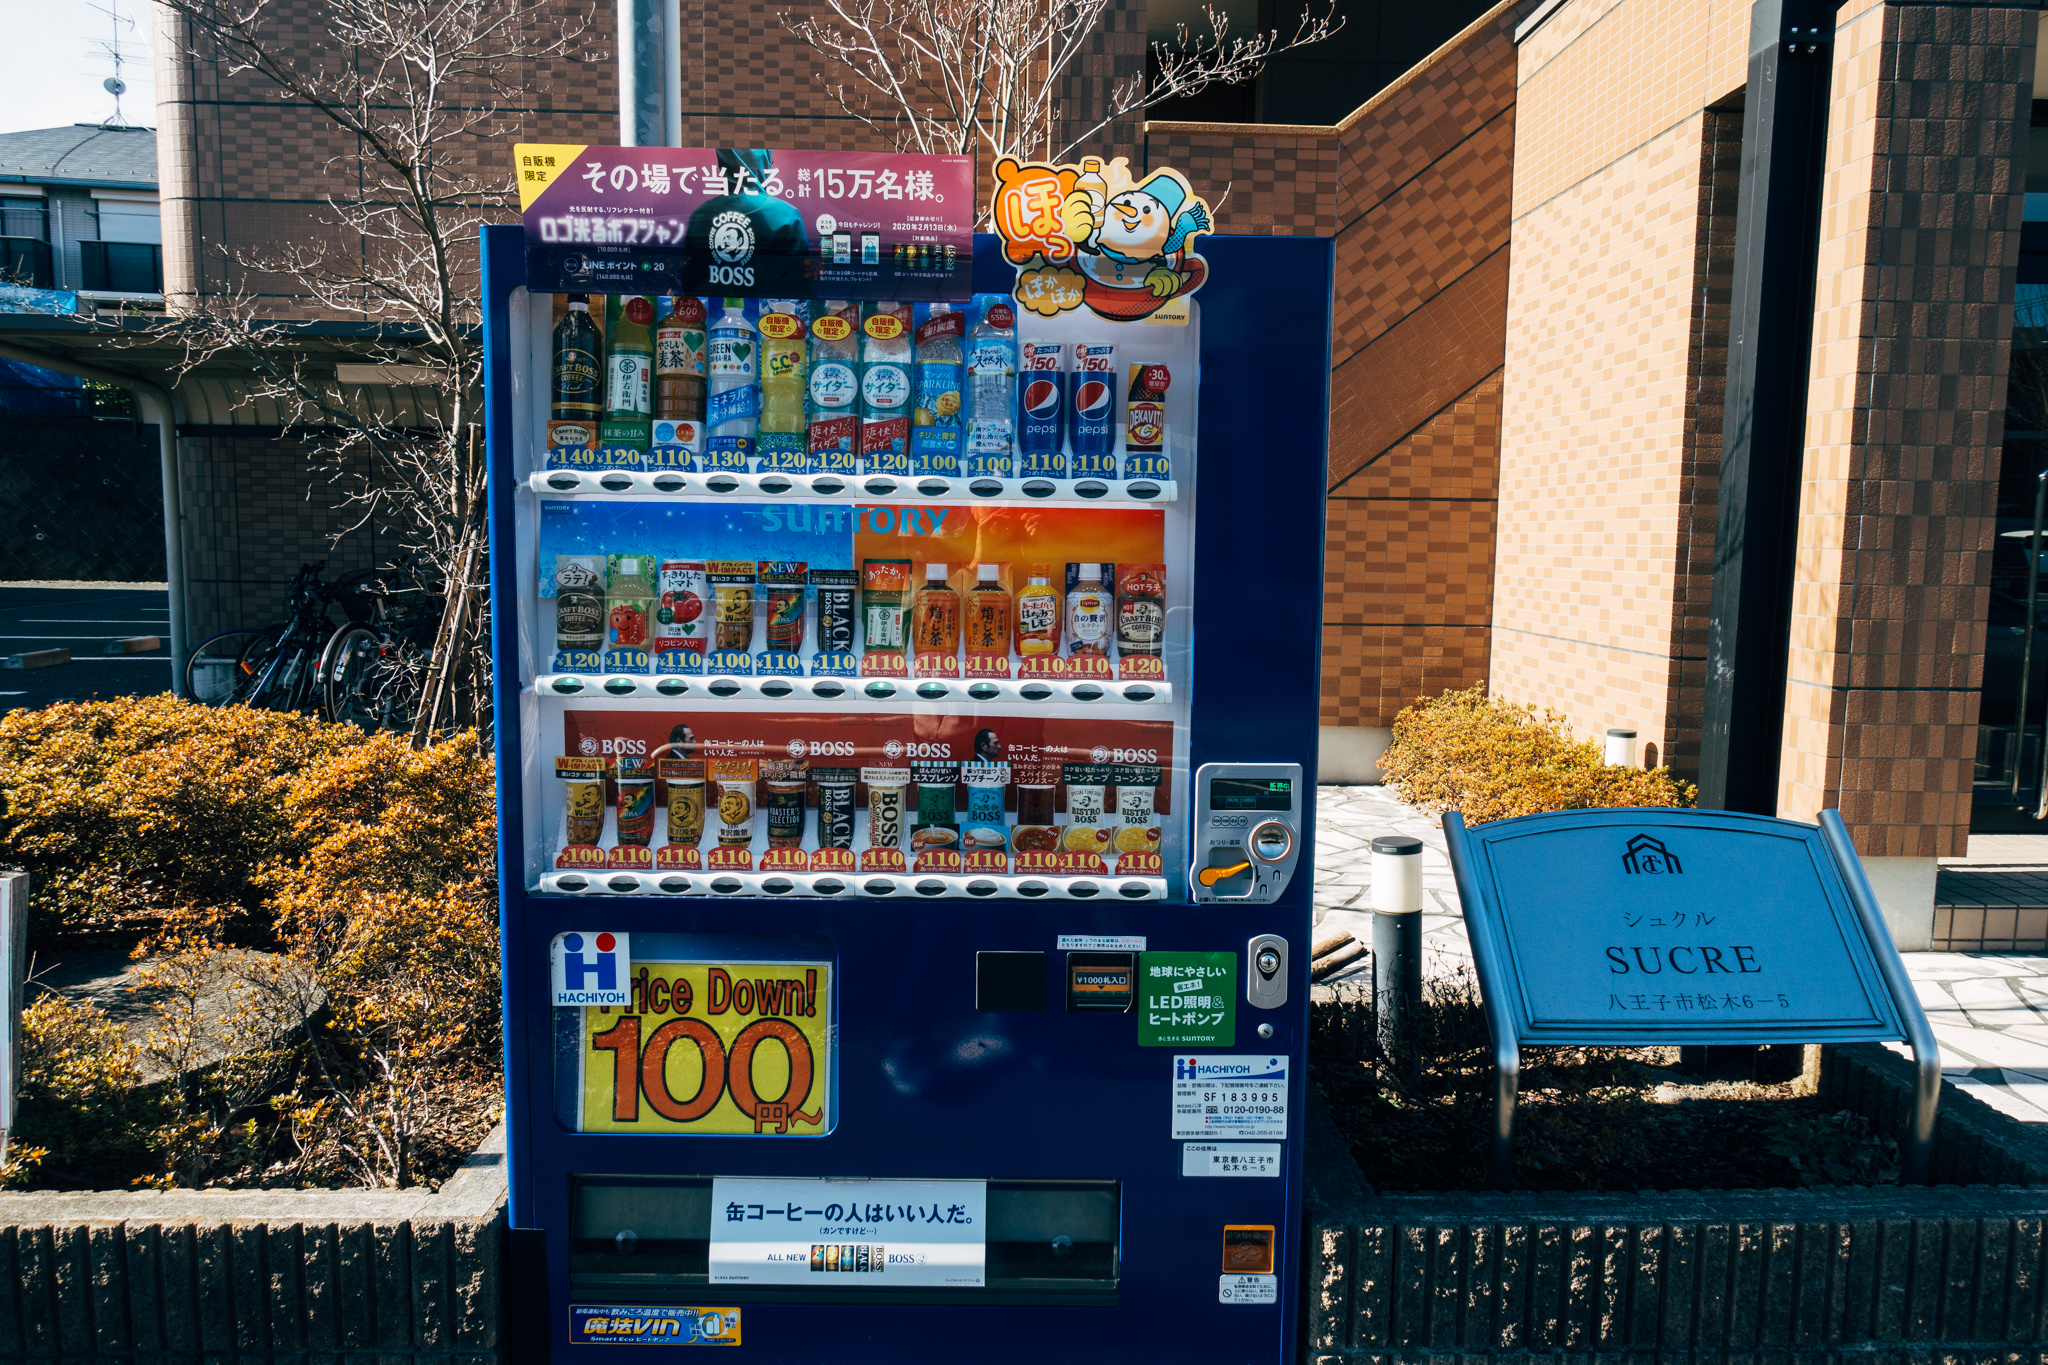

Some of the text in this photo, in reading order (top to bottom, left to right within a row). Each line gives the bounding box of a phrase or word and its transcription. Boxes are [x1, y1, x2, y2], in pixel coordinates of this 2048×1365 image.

[522, 156, 556, 167] 自販機
[525, 171, 547, 181] 限定
[713, 212, 751, 228] COFFEE
[540, 216, 685, 244] ロゴ光るボスジャン
[584, 261, 664, 271] LINE ポイント 20
[709, 265, 754, 286] BOSS
[766, 316, 789, 325] 自販機
[820, 319, 843, 327] 自販機
[871, 317, 895, 326] 自販機
[658, 352, 684, 369] 麦茶
[975, 355, 1008, 369] 天然水
[622, 375, 632, 407] 伊右衛門
[813, 381, 853, 393] サイダー
[864, 382, 906, 394] サイダー
[1129, 410, 1164, 431] DEKAVITA
[1027, 424, 1057, 435] pepsi
[1079, 424, 1109, 436] pepsi
[1140, 424, 1153, 438] C
[552, 450, 594, 464] ¥140
[597, 450, 639, 464] ¥120
[648, 450, 690, 465] ¥110
[703, 451, 745, 466] ¥130
[763, 452, 806, 467] ¥120
[812, 453, 855, 468] ¥120
[865, 454, 907, 468] ¥120
[915, 455, 956, 470] ¥100
[969, 457, 1011, 471] ¥100
[1023, 454, 1065, 470] ¥110
[1072, 455, 1115, 471] ¥110
[1126, 458, 1169, 474] ¥110
[708, 562, 753, 573] W-IMPACT
[768, 562, 797, 573] NEW
[869, 565, 905, 580] あったかい
[564, 574, 588, 585] ラテ!
[668, 579, 694, 588] トマト
[578, 606, 599, 615] BOSS
[1022, 609, 1054, 618] はちみつ
[833, 591, 850, 653] BLACK
[929, 605, 944, 646] 焙じ茶
[981, 606, 995, 647] 焙じ茶
[1032, 618, 1054, 628] レモン
[557, 653, 599, 667] ¥120
[605, 653, 648, 667] ¥110
[659, 653, 701, 667] ¥110
[708, 654, 750, 668] ¥100
[757, 654, 799, 669] ¥110
[813, 655, 855, 670] ¥110
[863, 655, 904, 670] ¥110
[915, 656, 956, 670] ¥110
[966, 657, 1008, 671] ¥110
[1022, 658, 1064, 672] ¥110
[1067, 658, 1108, 673] ¥110
[1120, 659, 1162, 673] ¥120
[601, 739, 646, 754] BOSS
[704, 739, 764, 747] 缶コーヒーの人は
[810, 741, 855, 756] BOSS
[1008, 744, 1068, 753] 缶コーヒーの人は
[704, 749, 737, 757] いい人だ。
[906, 743, 951, 758] BOSS
[1008, 753, 1041, 761] いい人だ。
[1112, 749, 1157, 763] BOSS
[557, 758, 603, 769] W-IMPACT
[615, 758, 644, 769] NEW
[713, 760, 752, 773] 今だけ!
[913, 774, 959, 783] エスプレッソ
[963, 774, 999, 782] カプチーノ
[1064, 774, 1108, 782] コーンスープ
[1114, 775, 1159, 783] コーンスープ
[769, 807, 800, 816] ROASTER'S
[972, 811, 1000, 821] BOSS
[1072, 807, 1100, 815] BISTRO
[1122, 808, 1150, 816] BISTRO
[769, 816, 799, 824] SELECTION
[832, 788, 849, 849] BLACK
[881, 792, 898, 847] BOSS
[1075, 815, 1097, 823] BOSS
[1125, 816, 1148, 824] BOSS
[562, 849, 604, 863] ¥100
[609, 849, 651, 863] ¥110
[657, 850, 699, 863] ¥110
[708, 850, 750, 864] ¥110
[764, 851, 806, 865] ¥110
[812, 851, 853, 865] ¥110
[862, 852, 903, 866] ¥110
[919, 852, 960, 866] ¥110
[965, 853, 1006, 867] ¥110
[1016, 853, 1057, 867] ¥110
[1059, 854, 1100, 868] ¥110
[1119, 855, 1160, 868] ¥110
[1623, 911, 1716, 928] シュクル
[1605, 946, 1761, 974] SUCRE
[1150, 966, 1226, 977] 地球にやさしい
[1077, 976, 1126, 984] ¥1000札入口
[1176, 982, 1201, 991] 省エネ!
[558, 992, 625, 1003] HACHIYOH
[601, 967, 817, 1018] rice Down!
[1150, 996, 1224, 1009] LED照明&
[1149, 1012, 1224, 1025] ヒートポンプ
[1198, 1065, 1250, 1073] HACHIYOH
[1224, 1106, 1284, 1114] 0120-0190-88
[1213, 1156, 1274, 1164] 東京都八王子市
[726, 1202, 973, 1224] 缶コーヒーの人はいい人だ。
[888, 1254, 915, 1263] BOSS
